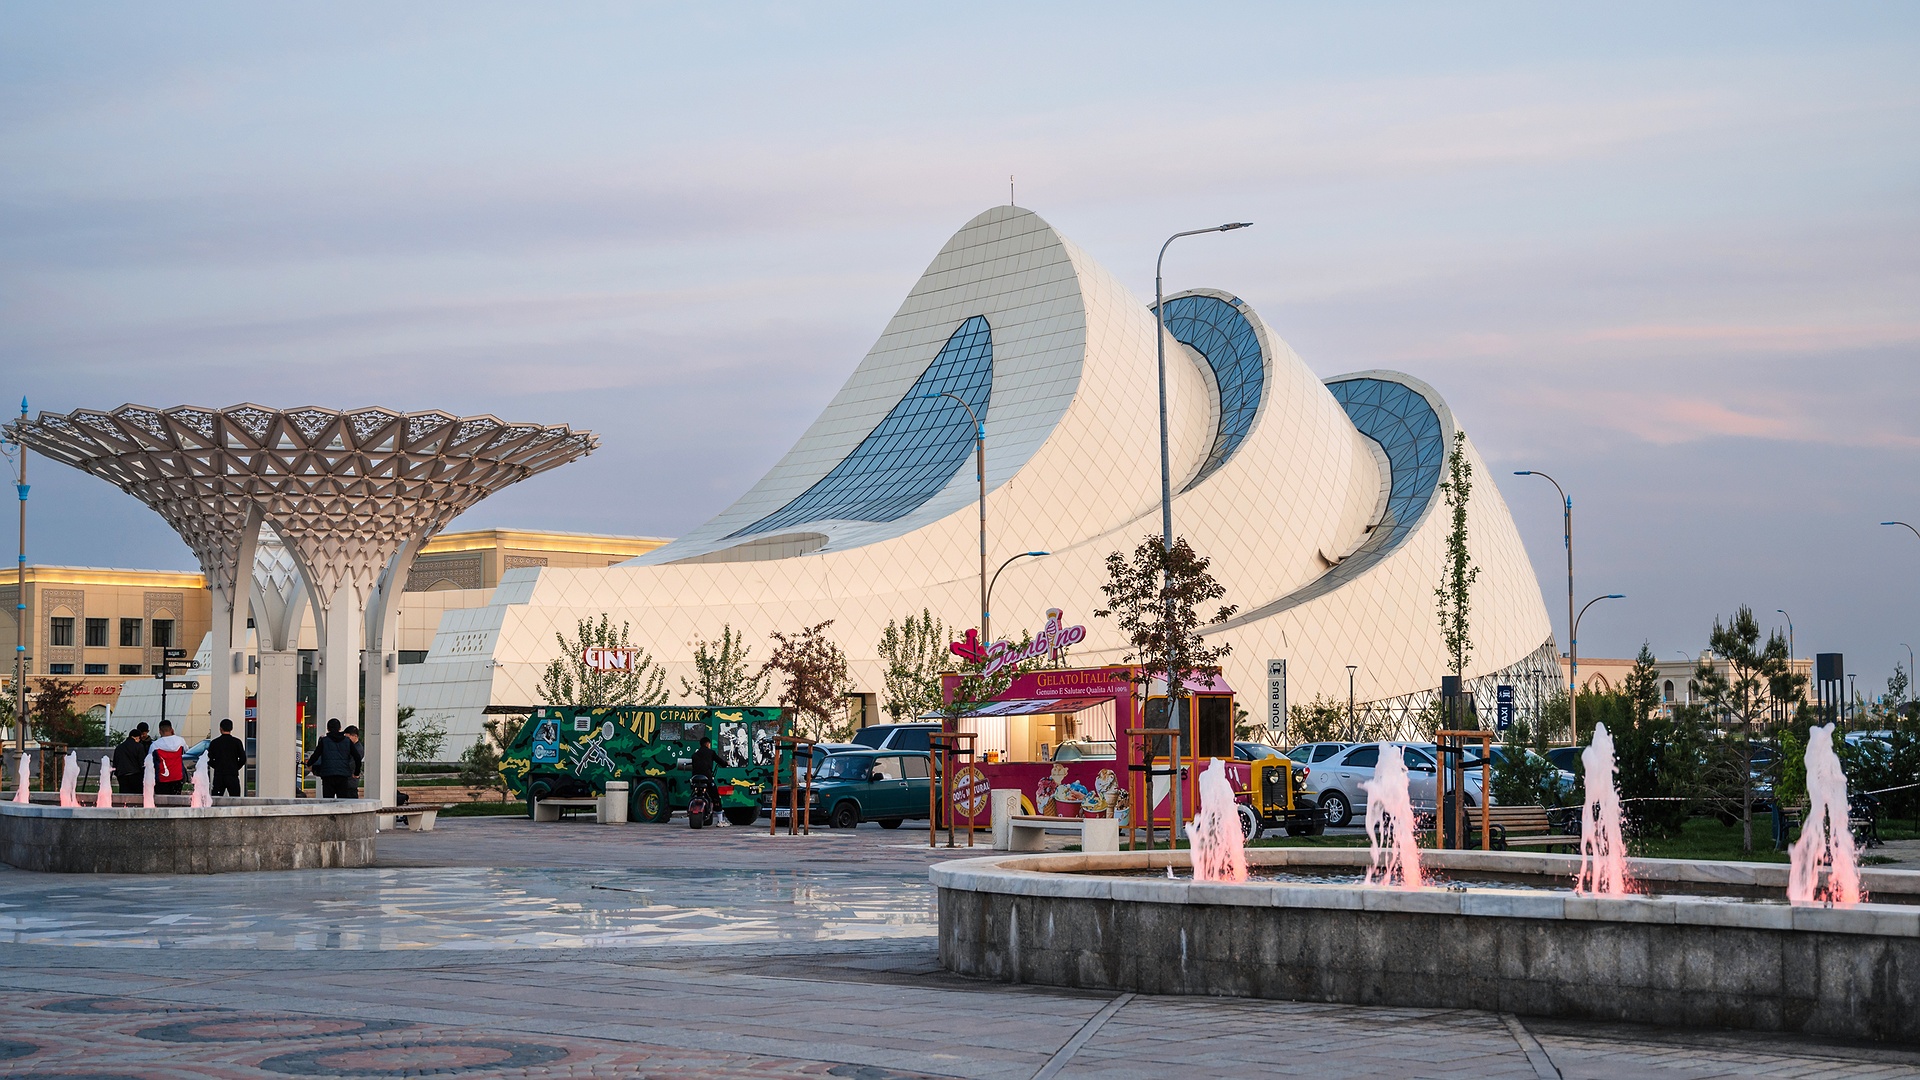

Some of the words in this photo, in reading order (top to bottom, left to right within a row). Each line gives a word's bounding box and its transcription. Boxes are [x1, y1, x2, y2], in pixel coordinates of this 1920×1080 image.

[1037, 673, 1079, 687] GELATO
[1080, 671, 1126, 684] ITALIAN
[1036, 688, 1058, 696] Genuino
[1064, 687, 1085, 695] Salutare
[1272, 681, 1280, 699] BUS
[1272, 702, 1280, 729] TOUR
[616, 711, 656, 744] ТИР
[660, 709, 701, 722] СТРАЙК
[953, 790, 966, 802] 00%
[965, 781, 990, 797] NTURAL
